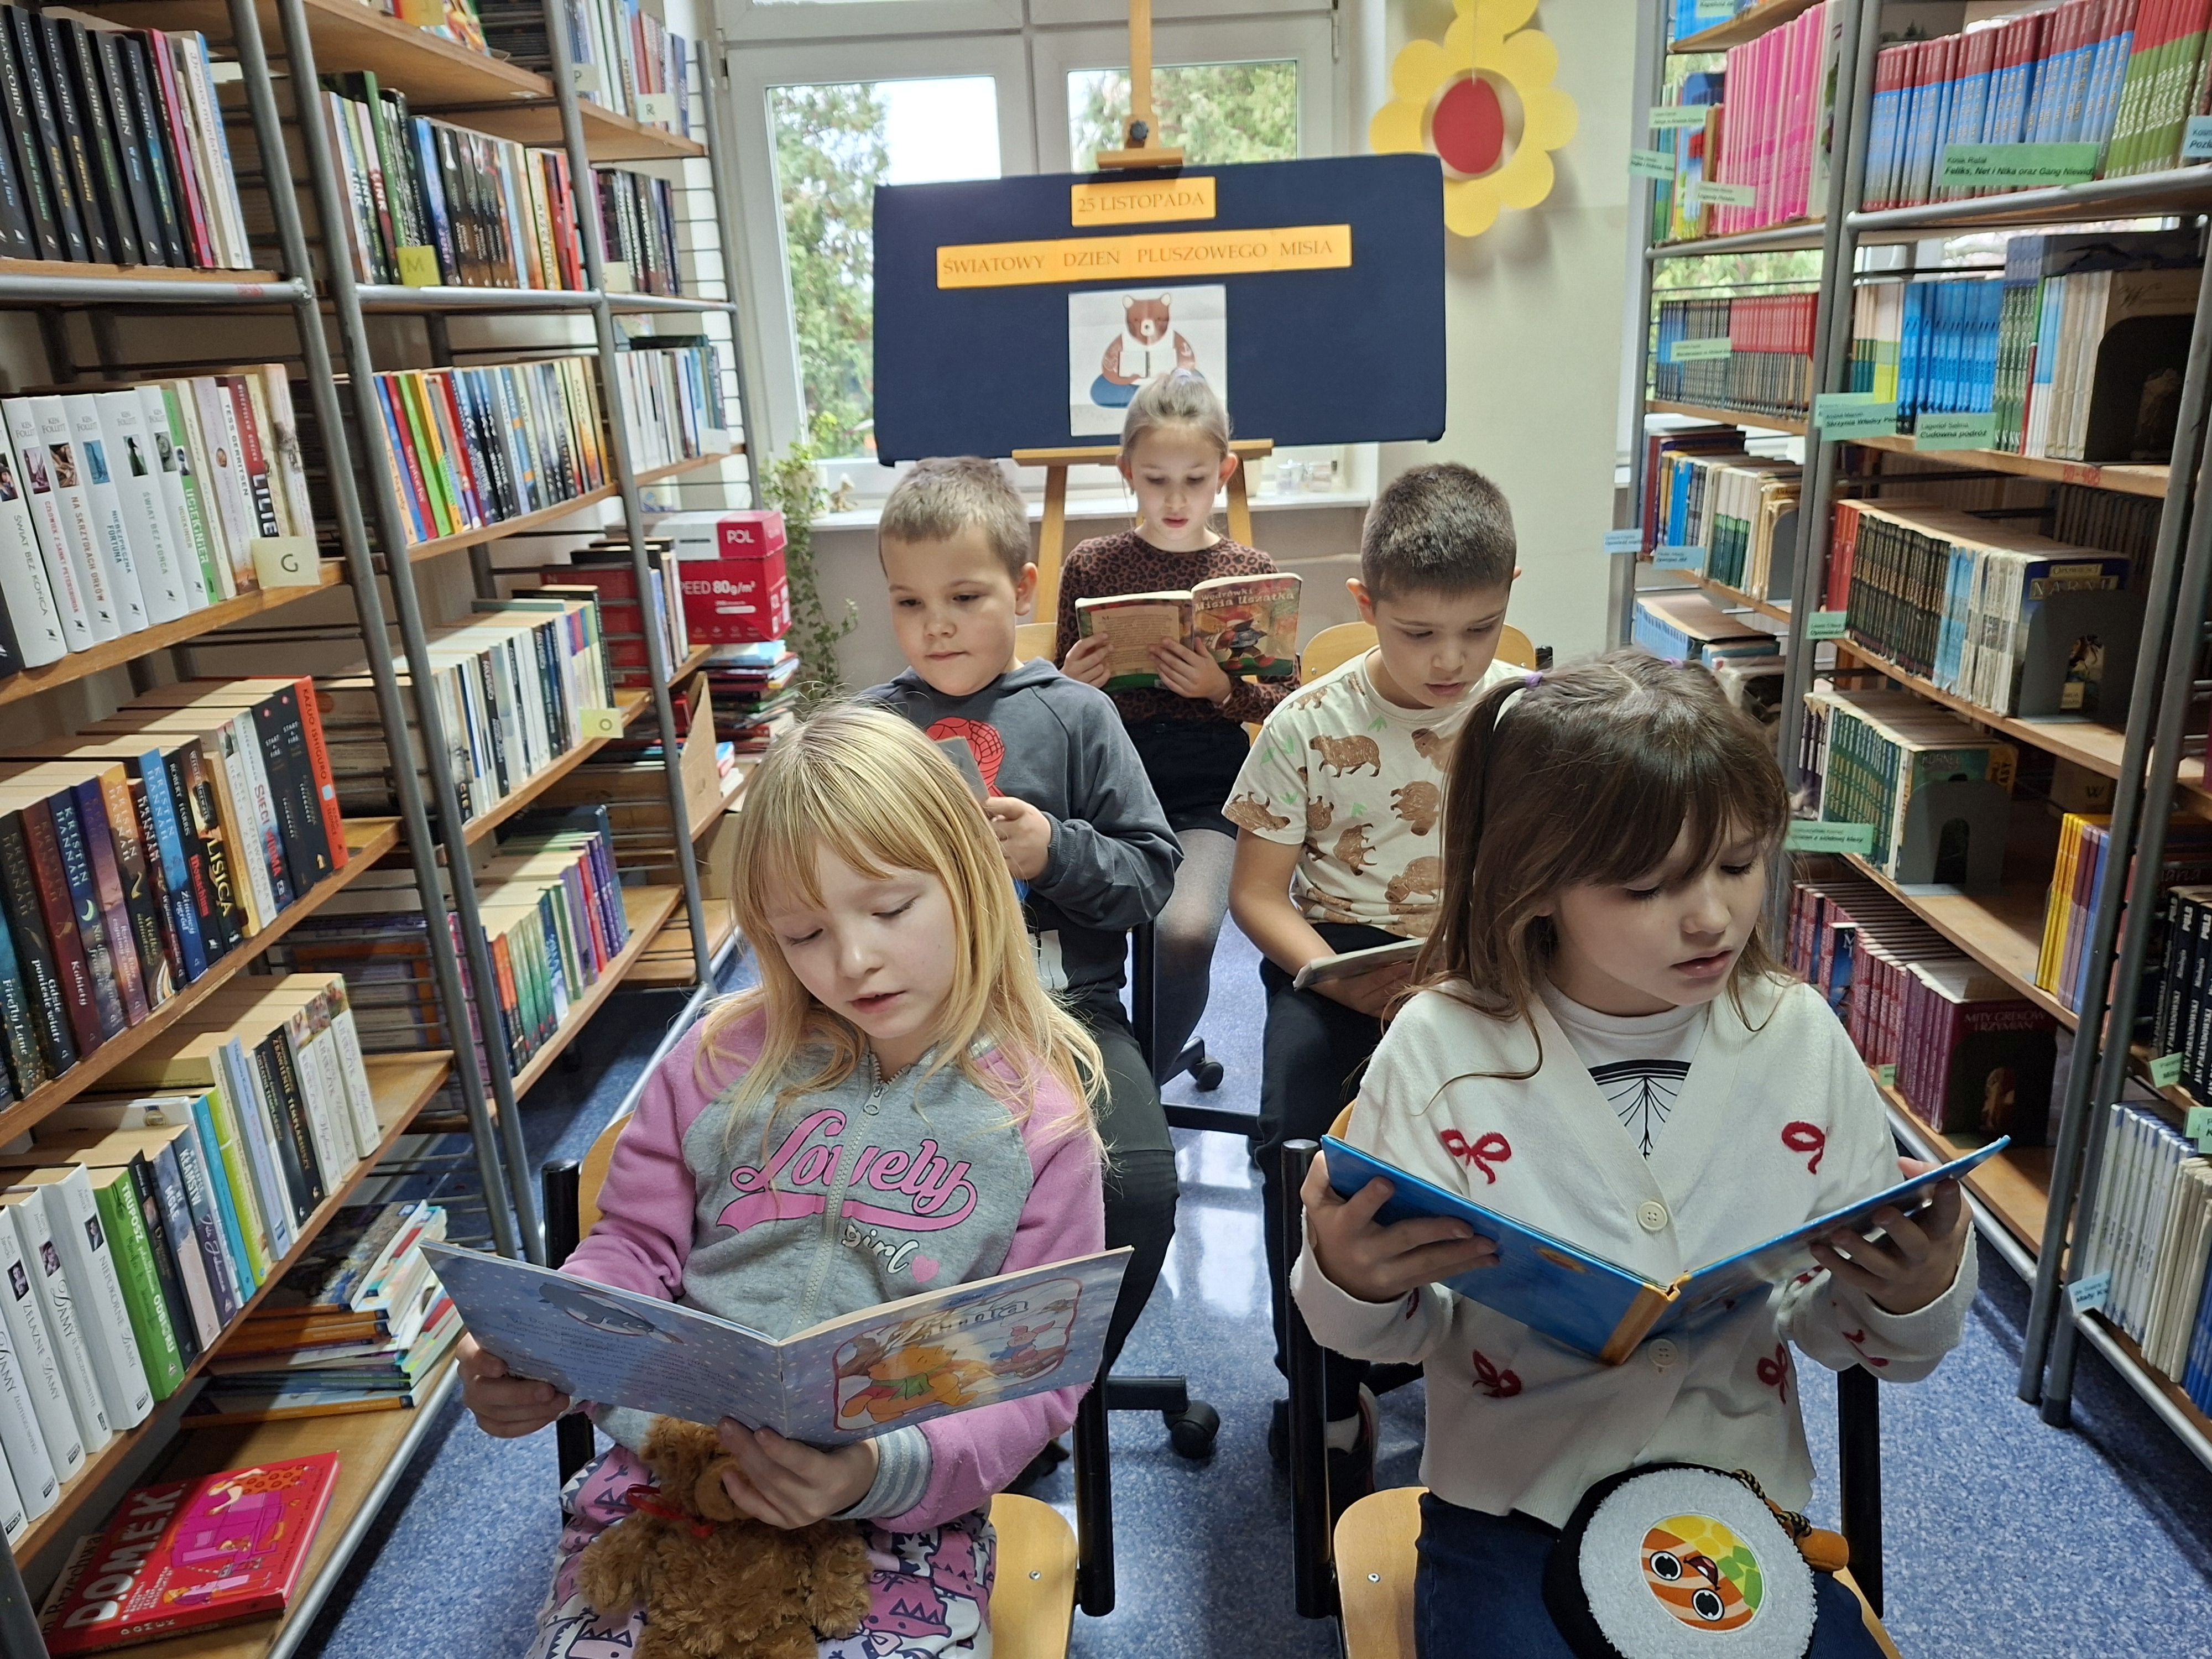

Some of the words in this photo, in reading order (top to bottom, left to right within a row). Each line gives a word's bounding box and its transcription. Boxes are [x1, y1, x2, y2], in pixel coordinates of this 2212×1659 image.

[6, 64, 24, 117] COBEN
[21, 22, 35, 64] HARLAN
[31, 67, 50, 121] COBEN
[47, 28, 60, 70] HARLAN
[57, 73, 75, 125] COBEN
[105, 44, 119, 85] HARLAN
[114, 87, 132, 137] COBEN
[87, 77, 104, 127] COBEN
[1077, 196, 1096, 213] 25
[1099, 191, 1206, 212] LISTOPADA
[942, 253, 1046, 274] ŚWIATOWY
[1063, 247, 1121, 268] DZIEŃ
[1136, 241, 1268, 264] PLUSZOWEGO
[1279, 238, 1334, 258] MISIA
[225, 404, 234, 431] TESS
[232, 435, 249, 496] GERRITSEN
[1921, 430, 1957, 438] Cudowna
[1958, 429, 1987, 439] podróż
[71, 496, 80, 509] NA
[75, 513, 96, 571] SKRZYDŁACH
[107, 525, 122, 564] FORTUNA
[111, 510, 132, 574] NIEBEZPIECZNA
[150, 523, 161, 541] BEZ
[726, 529, 755, 544] POL
[14, 514, 29, 547] ŚWIAT
[24, 551, 36, 571] BEZ
[32, 574, 48, 616] KOŃCA
[90, 572, 105, 602] ORŁÓW
[280, 553, 299, 572] G
[681, 581, 711, 595] PEED
[1194, 598, 1234, 613] Misia
[1238, 591, 1295, 607] Uszatka
[1201, 588, 1254, 602] Wędrówki
[302, 688, 314, 727] KAZUO
[311, 729, 326, 780] ISHIGURO
[599, 718, 612, 732] O
[109, 789, 130, 862] HANNAH
[116, 785, 137, 857] KRISTIN
[142, 795, 160, 859] KRISTIN
[147, 770, 169, 841] HANNAH
[154, 766, 175, 836] KRISTIN
[169, 763, 182, 799] ROBERT
[178, 802, 190, 837] HARRIS
[56, 811, 81, 887] HANNAH
[65, 806, 88, 883] KRISTIN
[138, 799, 157, 863] HANNAH
[254, 784, 270, 824] SIECI
[265, 827, 283, 877] WIDMA
[207, 838, 234, 917] LISICA
[92, 925, 104, 942] Na
[145, 916, 157, 956] Wielka
[176, 901, 189, 931] ogród
[181, 890, 197, 935] Zimowy
[32, 959, 51, 1009] poniesie
[47, 1011, 62, 1043] wiatr
[71, 961, 88, 1006] Kobiety
[3, 979, 20, 1022] Firefly
[15, 1025, 28, 1055] Lane
[273, 1040, 290, 1094] ZBAWIENIE
[179, 1148, 202, 1206] KŁAMSTW
[730, 1108, 979, 1215] Lovely
[165, 1185, 180, 1222] MGLE
[122, 1182, 144, 1243] TRUPOSZ
[153, 1294, 175, 1353] ODBIORU
[841, 1223, 920, 1275] girl
[50, 1279, 75, 1338] DAMY
[100, 1255, 125, 1327] NIEPOKORNE
[121, 1327, 137, 1368] DAMY
[23, 1300, 45, 1358] ŻELAZNE
[41, 1357, 60, 1400] DAMY
